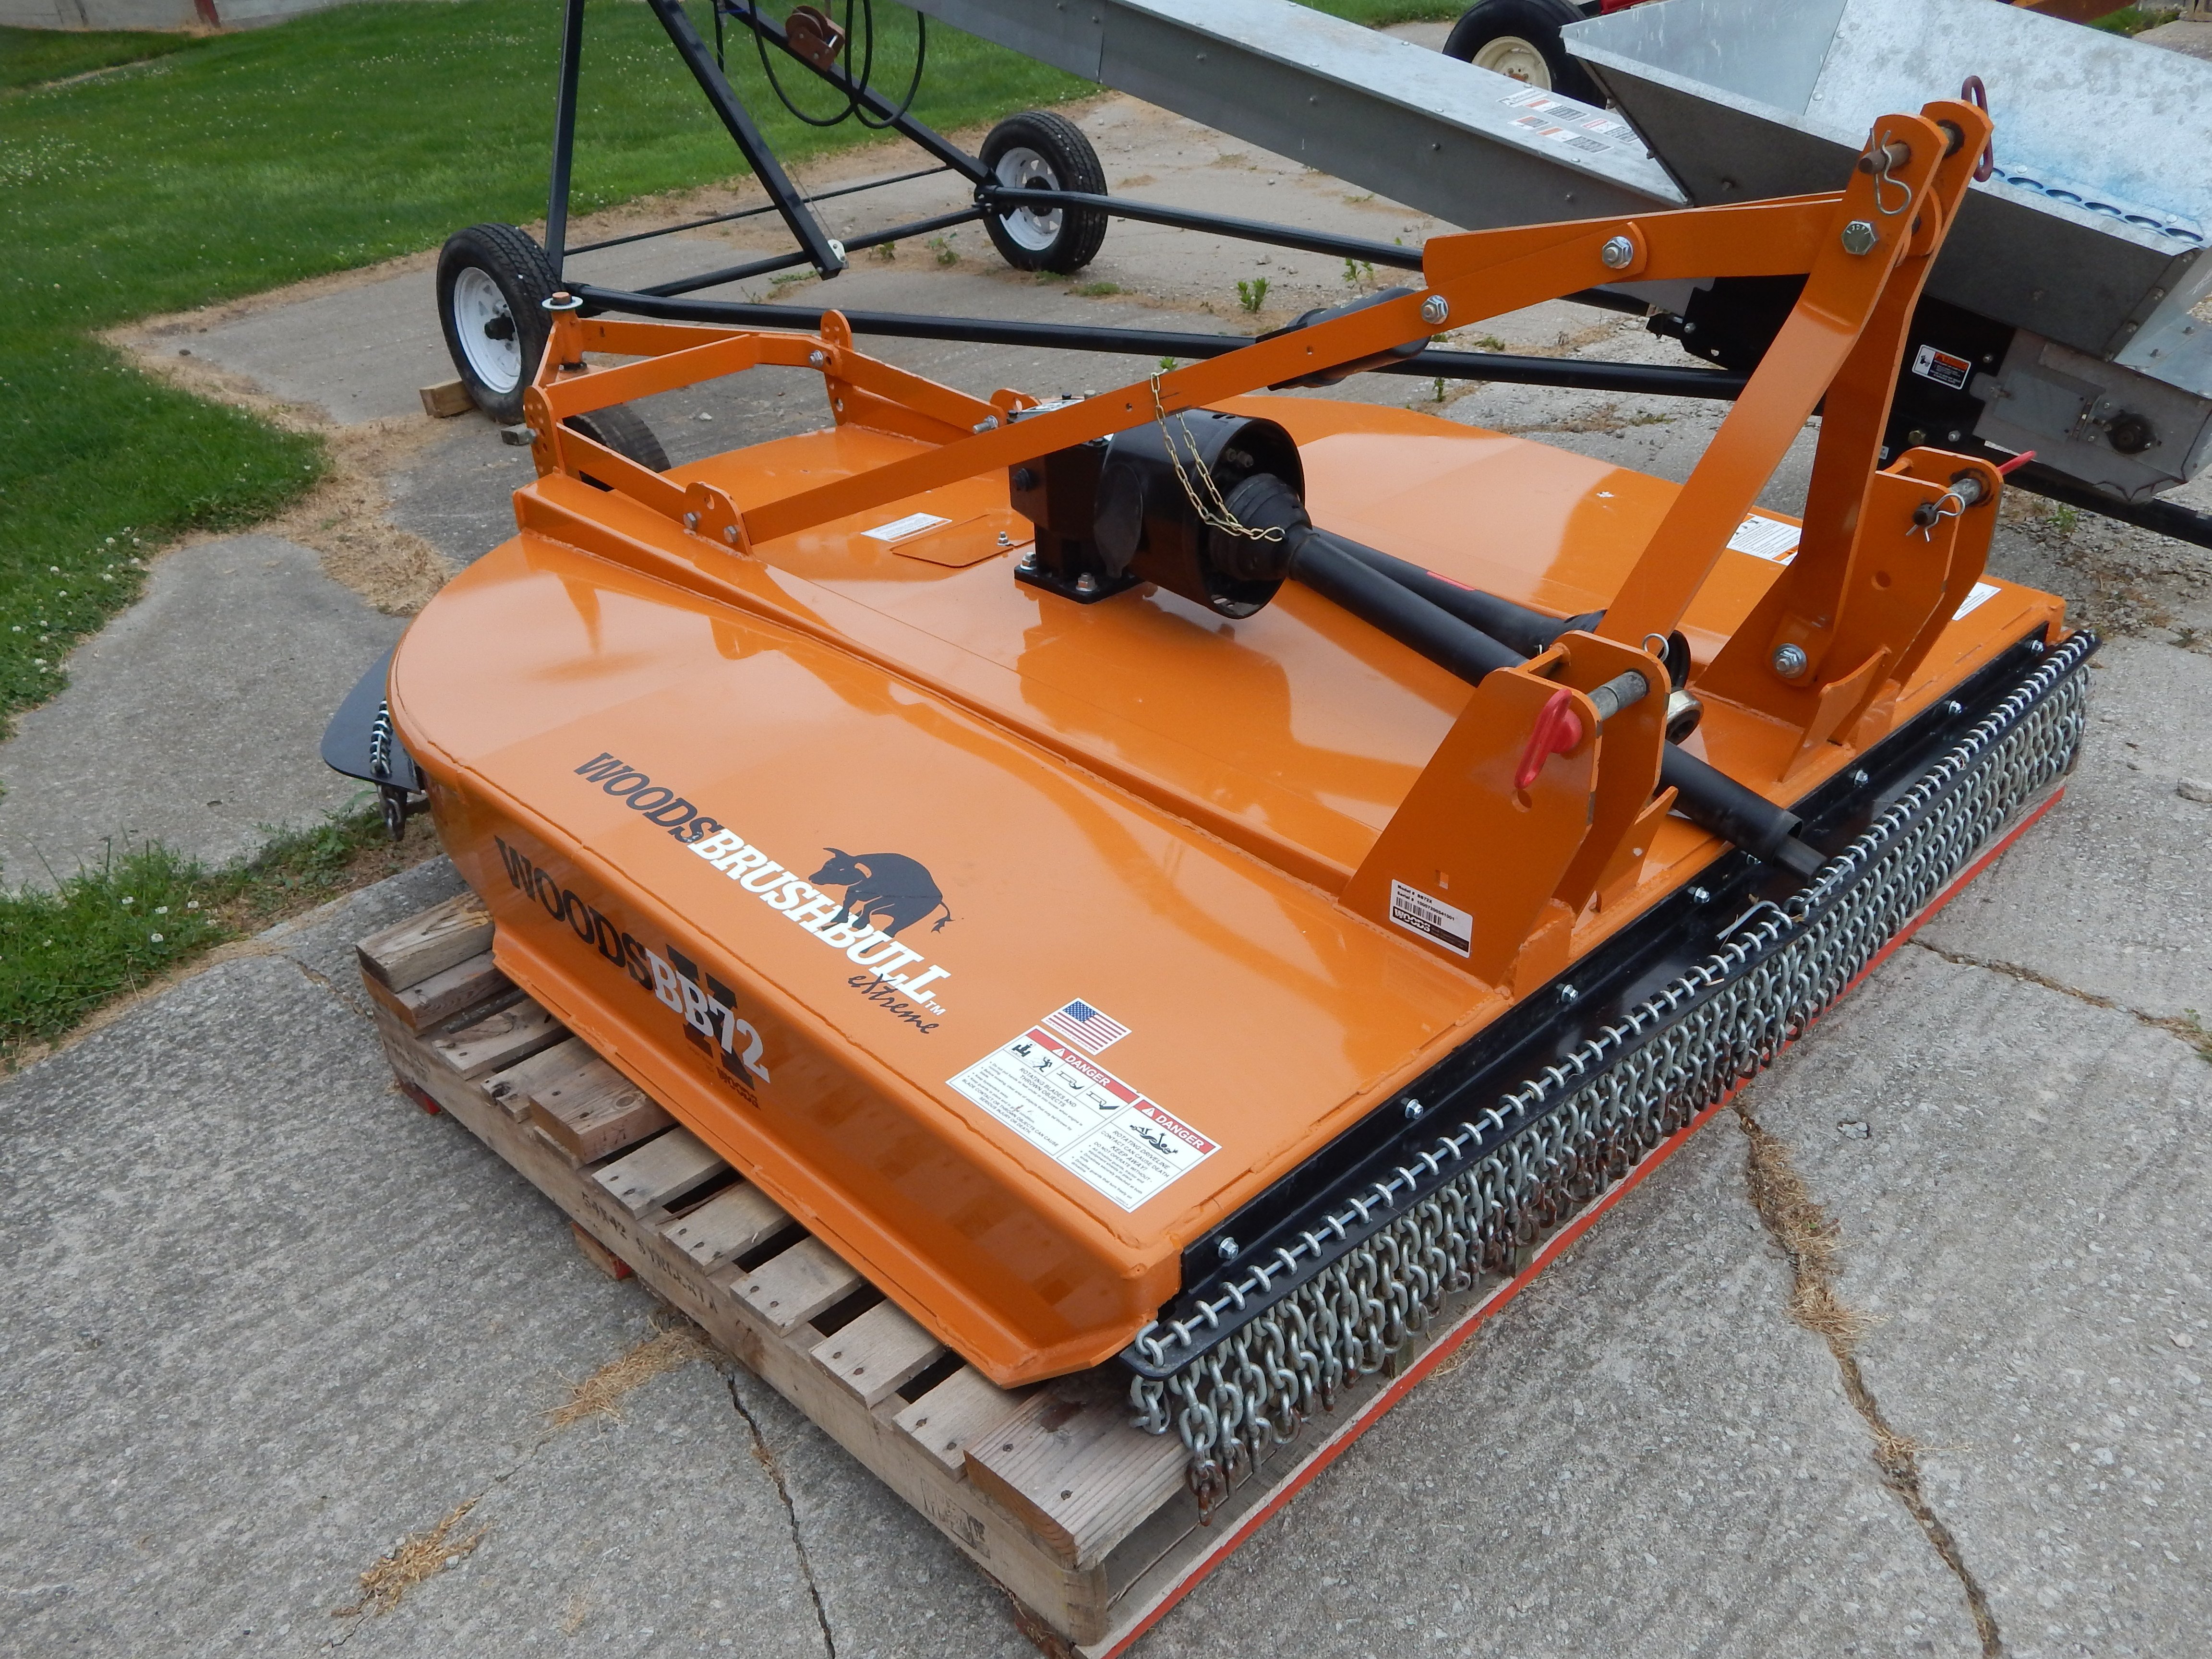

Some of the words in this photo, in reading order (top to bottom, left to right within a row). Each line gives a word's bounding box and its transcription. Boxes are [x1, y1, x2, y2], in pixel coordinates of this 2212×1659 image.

[1397, 891, 1410, 900] Serial
[1395, 908, 1431, 932] WOODS
[494, 835, 654, 991] WOODS
[645, 948, 770, 1083] BB72
[1065, 1055, 1110, 1086] DANGER
[1019, 1068, 1045, 1085] ROTATING
[1044, 1084, 1065, 1099] BLADES
[1064, 1099, 1077, 1107] AND
[1020, 1075, 1042, 1091] THROWN
[1041, 1090, 1066, 1107] OBJECTS
[962, 1079, 976, 1089] BLADE
[975, 1088, 994, 1101] CONTACT
[999, 1105, 1017, 1118] THROWN
[1016, 1117, 1035, 1130] OBJECTS
[1044, 1136, 1059, 1147] CAUSE
[1155, 1115, 1204, 1148] DANGER
[1101, 1131, 1125, 1147] CONTACT
[1124, 1146, 1135, 1154] CAN
[1134, 1154, 1153, 1166] CAUSE
[1151, 1165, 1169, 1178] DEATH
[1110, 1146, 1128, 1156] KEEP
[1126, 1157, 1148, 1170] AWAY!
[1113, 1130, 1141, 1150] ROTATING
[1140, 1149, 1170, 1169] DRIVELINE
[1110, 1153, 1131, 1167] OPERATE
[1130, 1166, 1151, 1180] WITHOUT
